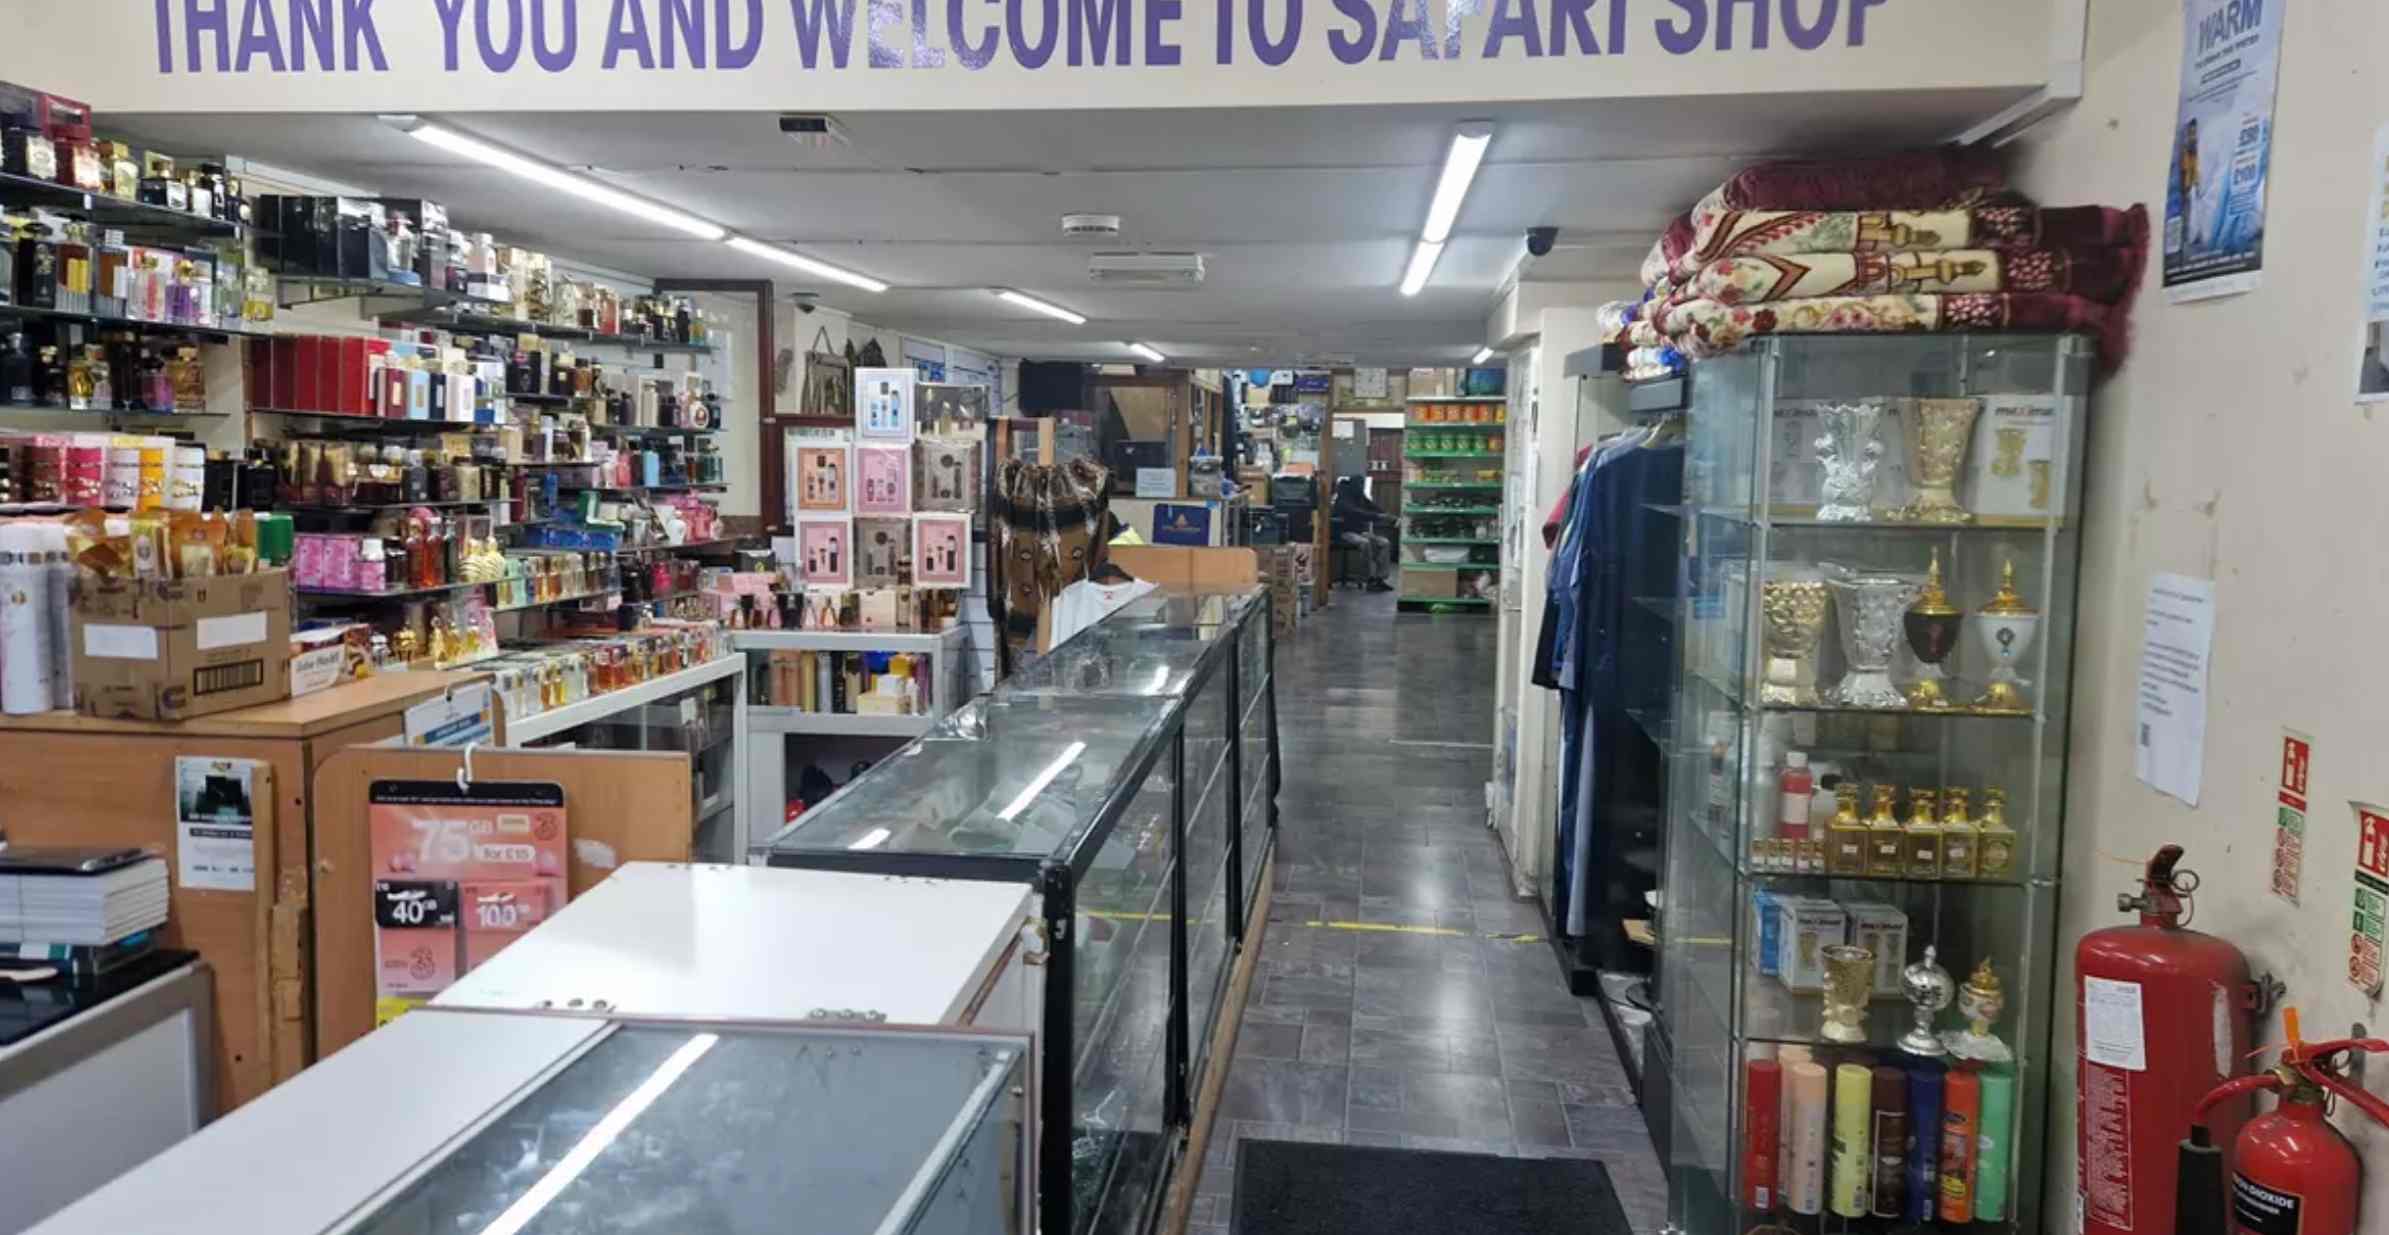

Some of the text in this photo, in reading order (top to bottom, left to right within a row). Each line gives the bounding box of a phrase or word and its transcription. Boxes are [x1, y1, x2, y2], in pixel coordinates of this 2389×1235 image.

[432, 0, 578, 73] YOU
[602, 0, 764, 71] AND
[790, 0, 1183, 71] WELCOME
[2198, 0, 2262, 57] WARM
[392, 900, 424, 924] 40
[476, 904, 516, 928] 100
